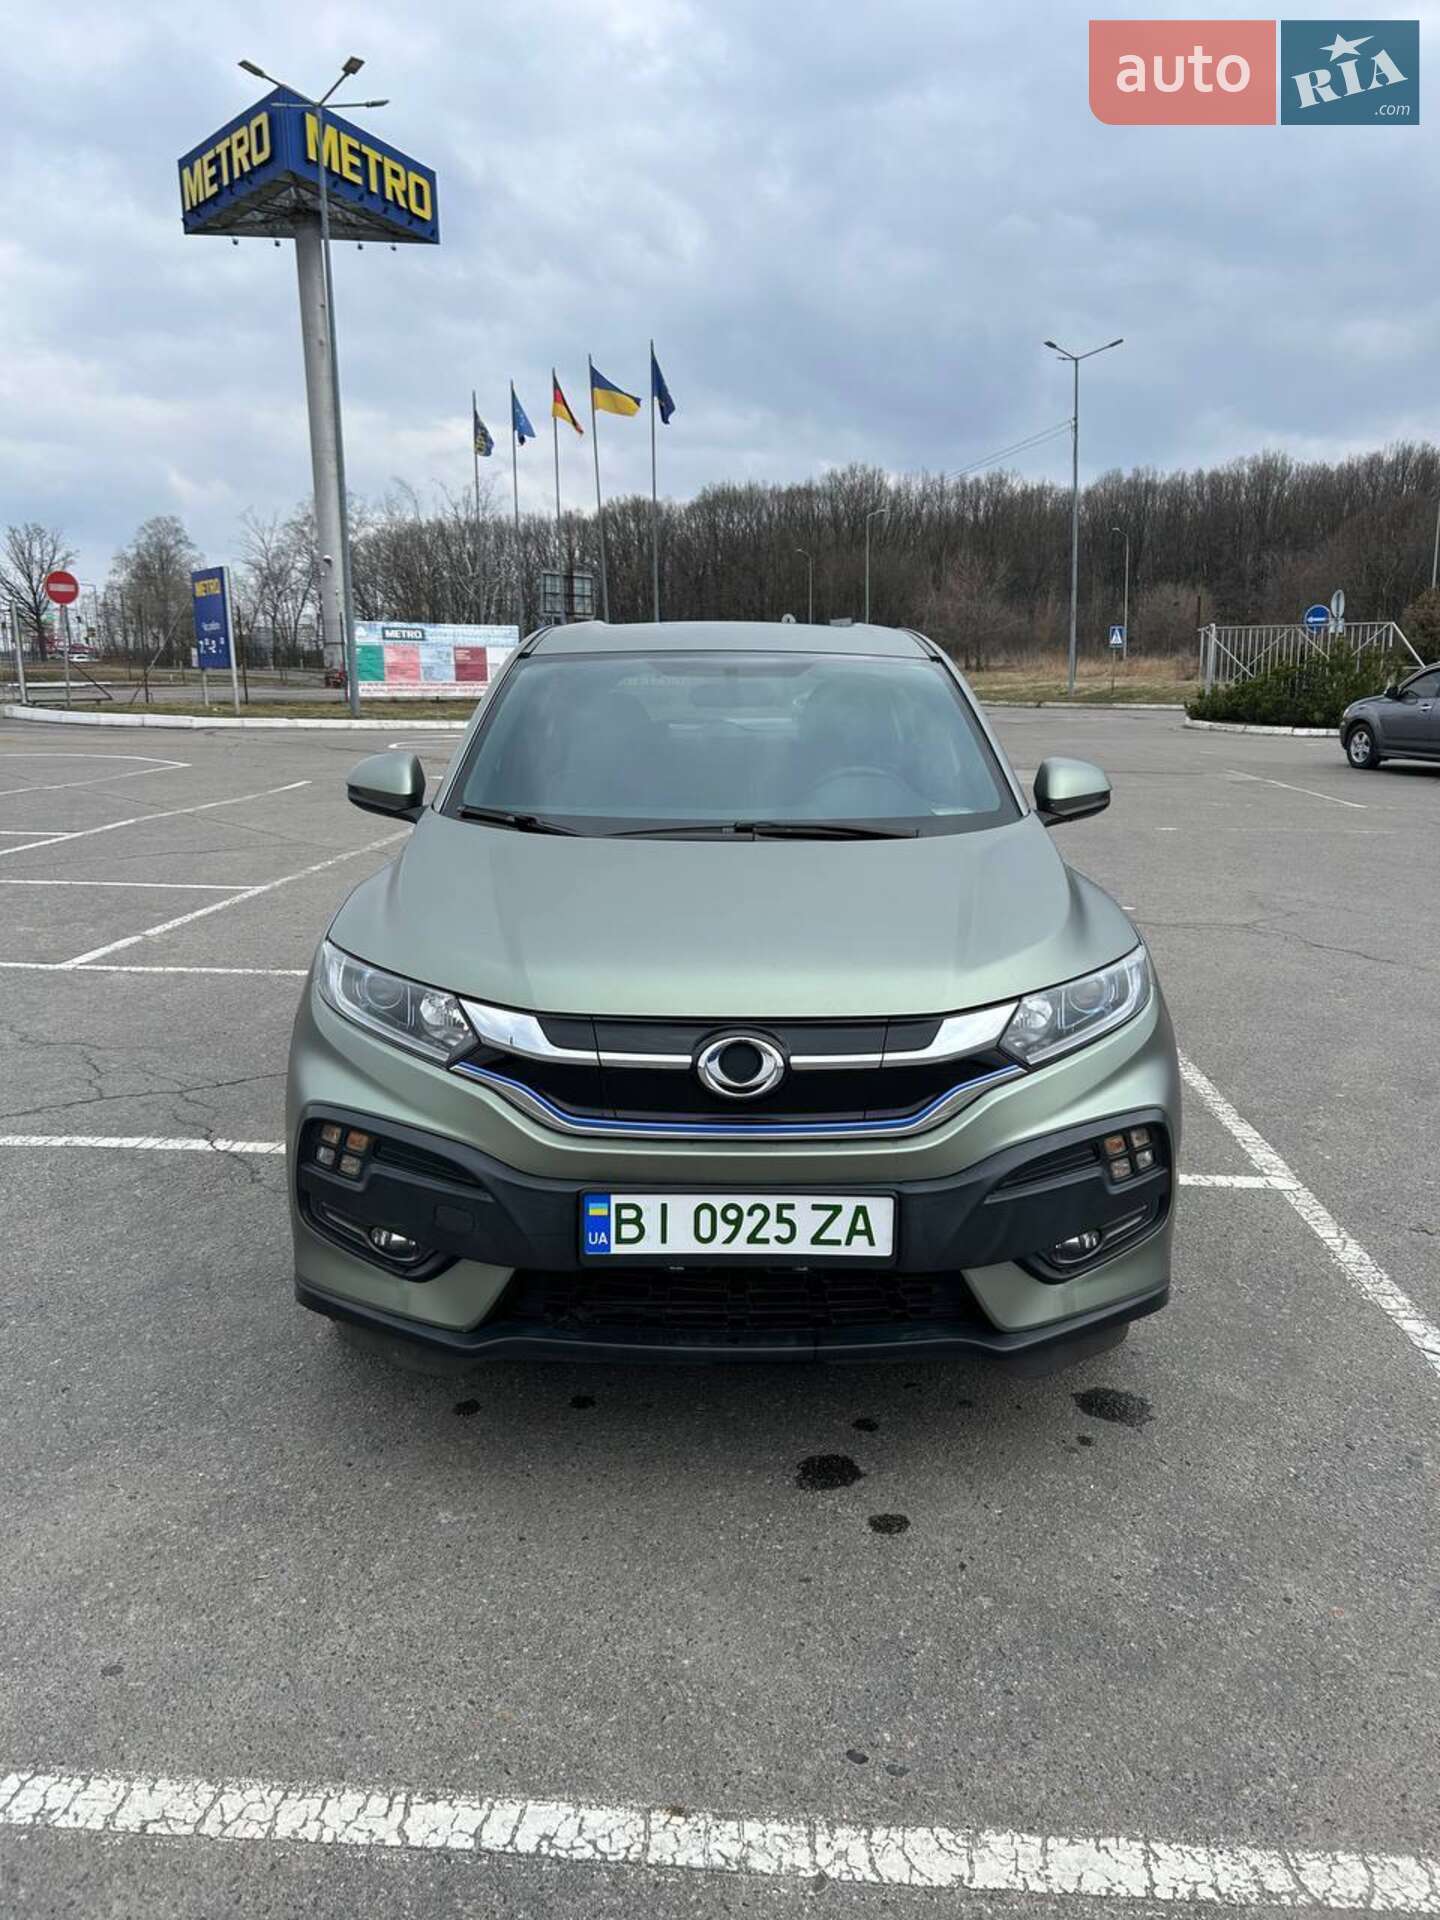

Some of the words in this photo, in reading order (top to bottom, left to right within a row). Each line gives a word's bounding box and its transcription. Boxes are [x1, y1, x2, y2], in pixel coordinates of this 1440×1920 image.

[182, 111, 271, 212] METRO
[304, 111, 432, 222] METRO
[194, 578, 220, 597] METRO
[384, 629, 423, 639] METRO
[588, 1231, 609, 1246] UA
[614, 1202, 668, 1245] BI
[693, 1202, 797, 1245] 0925
[810, 1203, 876, 1247] ZA
